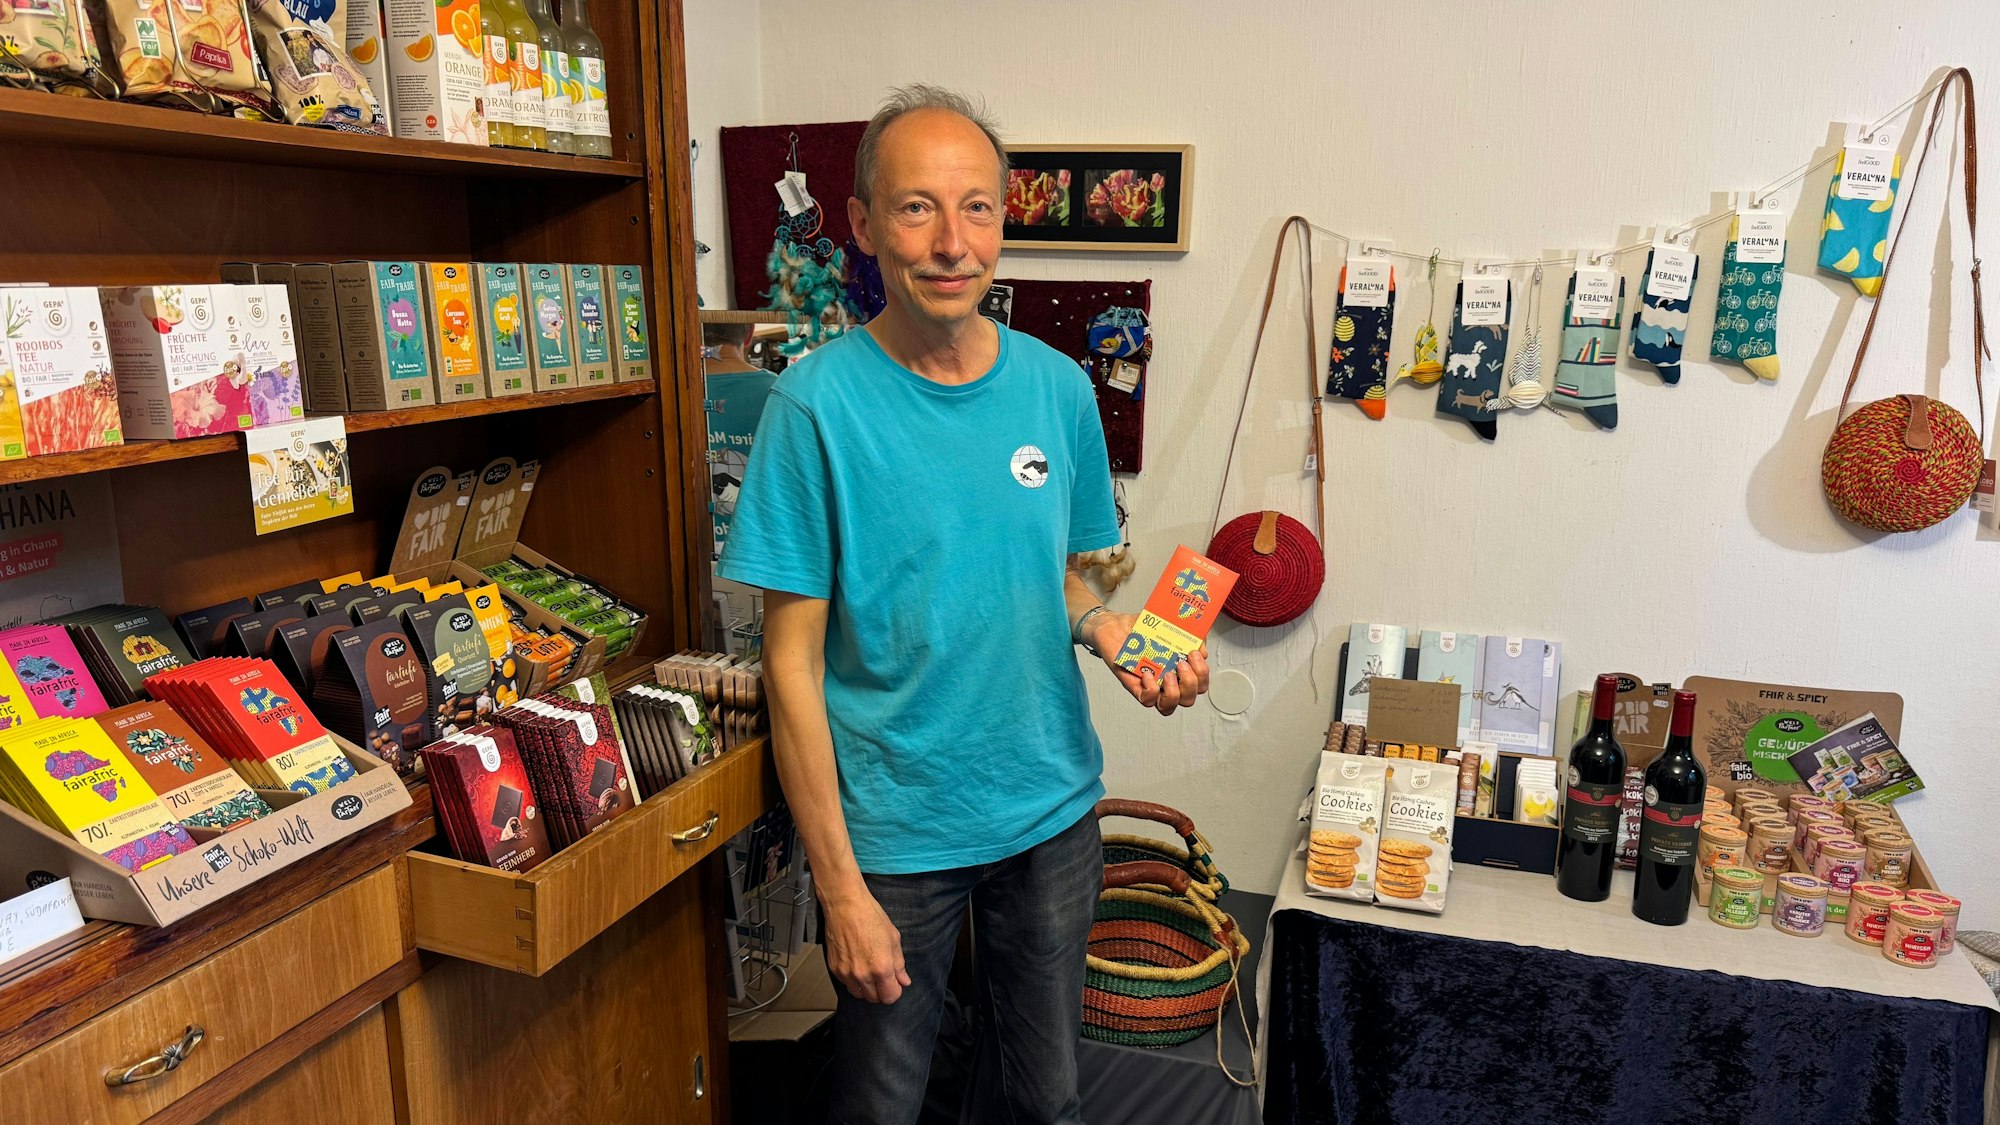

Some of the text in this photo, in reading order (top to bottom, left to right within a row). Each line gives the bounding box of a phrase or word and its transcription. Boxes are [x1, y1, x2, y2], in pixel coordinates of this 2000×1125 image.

[142, 40, 159, 51] Fair
[199, 46, 228, 66] Paprika
[445, 61, 482, 79] ORANGE
[298, 94, 324, 108] 100%
[380, 279, 415, 292] FAIR TRADE
[436, 281, 467, 294] FAIR TRADE
[488, 280, 517, 292] FAIR TRADE
[532, 282, 561, 293] FAIR TRADE
[574, 280, 600, 291] FAIR TRADE
[617, 282, 641, 292] FAIR TRADE
[43, 300, 62, 308] GEPA
[392, 309, 408, 319] Buona
[445, 309, 465, 318] Curcuma
[397, 318, 412, 327] Notte
[452, 317, 462, 325] Sun
[167, 333, 207, 344] FRÜCHTE
[16, 340, 63, 352] ROOIBOS
[168, 344, 186, 354] TEE
[17, 352, 38, 362] TEE
[170, 352, 217, 364] MISCHUNG
[20, 362, 54, 373] NATUR
[290, 429, 305, 438] GEPA
[257, 463, 306, 489] Tee für
[420, 480, 445, 494] Partner
[258, 483, 320, 509] Genießer
[10, 538, 58, 557] in Ghana
[6, 557, 50, 575] & Natur
[1170, 586, 1206, 611] fairafric
[113, 622, 126, 630] MADE
[133, 616, 149, 625] AFRICA
[452, 619, 472, 631] Partner
[1142, 614, 1160, 630] 80%
[9, 641, 22, 649] MADE
[31, 635, 49, 644] AFRICA
[386, 640, 400, 648] WELT
[453, 633, 482, 657] tartufi
[384, 644, 405, 656] Partner
[136, 655, 180, 674] fairafric
[248, 670, 261, 679] AFRICA
[386, 659, 417, 685] tartufi
[30, 676, 79, 697] fairafric
[442, 681, 458, 696] fair
[1759, 690, 1829, 704] FAIR & SPICY
[114, 718, 127, 727] MADE
[136, 711, 152, 720] AFRICA
[256, 705, 297, 725] fairafric
[374, 707, 390, 724] fair
[34, 738, 49, 747] MADE
[57, 730, 77, 740] AFRICA
[1847, 741, 1861, 751] FAIR
[1866, 732, 1883, 743] SPICY
[144, 744, 194, 765] fairafric
[482, 744, 494, 753] GEPA
[275, 752, 298, 771] 80%
[63, 767, 118, 792] fairafric
[1736, 771, 1753, 780] bio
[167, 790, 195, 809] 70%
[364, 789, 374, 797] FAIR
[367, 795, 383, 804] BESSER
[1331, 788, 1345, 797] Honig
[1346, 789, 1365, 797] Cashew
[338, 797, 356, 808] WELT
[1320, 794, 1373, 812] Cookies
[1401, 796, 1415, 804] Honig
[1416, 798, 1435, 806] Cashew
[335, 801, 360, 818] Partner
[1390, 803, 1444, 822] Cookies
[81, 801, 159, 843] 70% ZARTBITTERSCHOKOLADE
[157, 869, 215, 902] Unsere
[214, 854, 230, 870] bio
[232, 815, 315, 872] Schoko-Welt
[498, 847, 536, 872] FEINHERB
[1834, 906, 1846, 914] der
[1904, 942, 1931, 951] HARISSA
